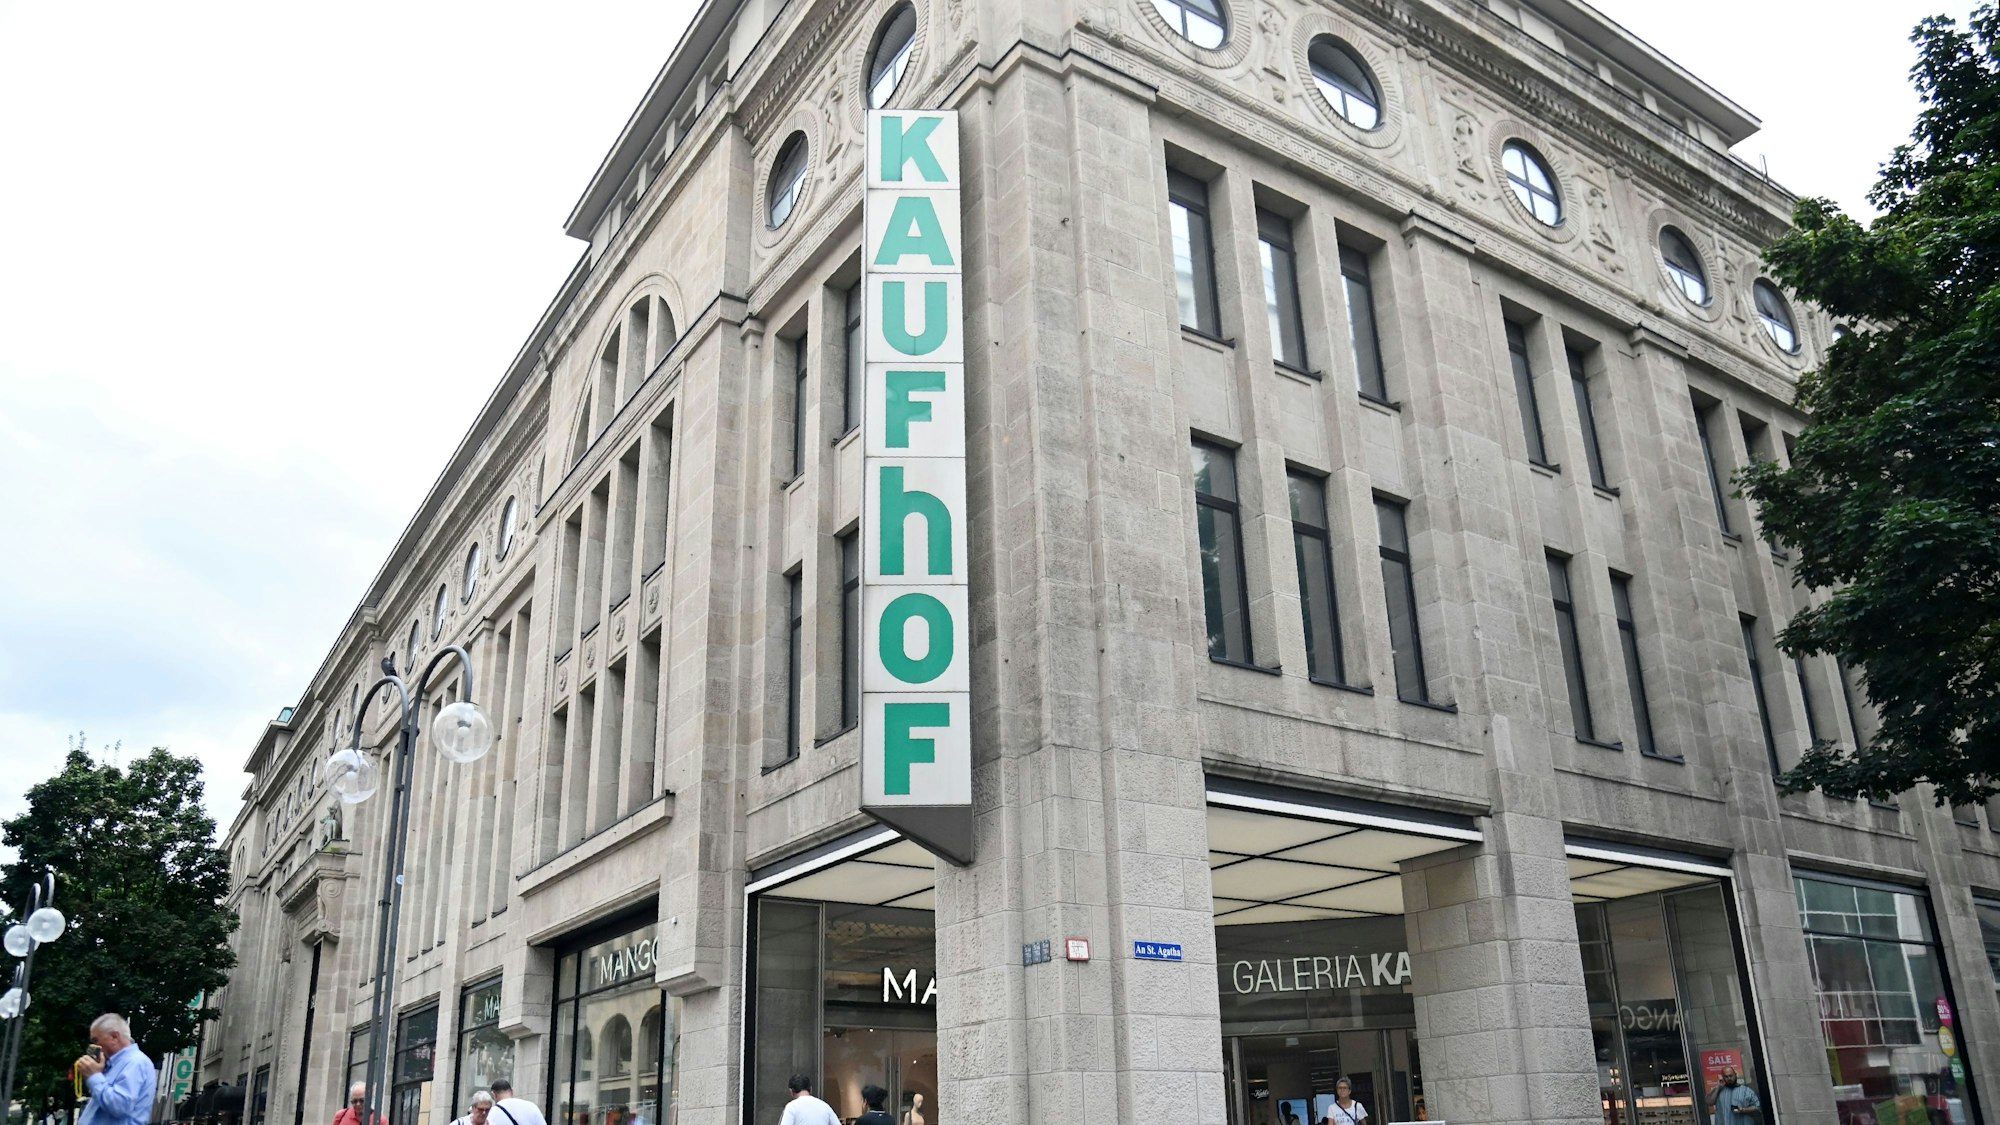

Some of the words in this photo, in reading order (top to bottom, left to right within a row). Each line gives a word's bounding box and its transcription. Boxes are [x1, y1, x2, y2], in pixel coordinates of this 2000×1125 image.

[1135, 944, 1146, 955] An
[1146, 944, 1157, 956] St.
[1157, 946, 1181, 959] Agatha
[1232, 954, 1367, 994] GALERIA
[1708, 1055, 1733, 1065] SALE
